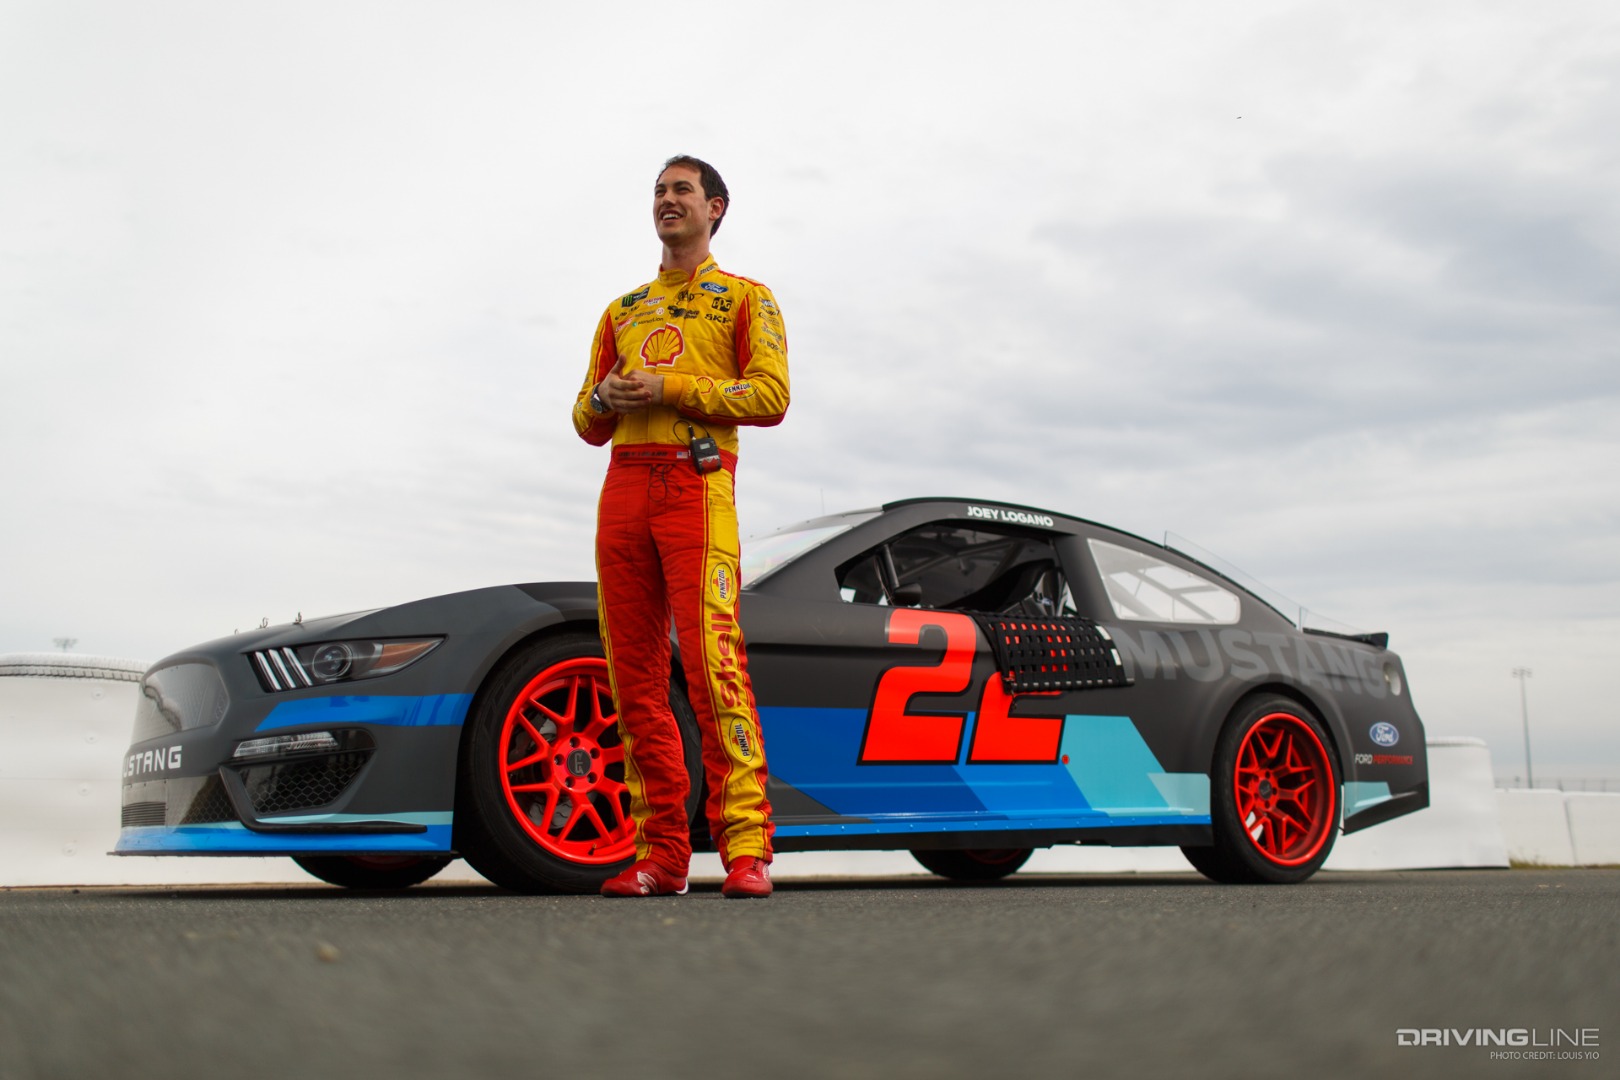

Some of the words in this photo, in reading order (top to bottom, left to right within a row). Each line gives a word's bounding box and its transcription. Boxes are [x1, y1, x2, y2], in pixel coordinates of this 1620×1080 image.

[703, 282, 725, 293] Ford
[712, 297, 732, 311] PPG
[704, 313, 732, 323] SKF
[724, 383, 751, 394] PENNZOIL
[967, 505, 999, 520] JOEY
[1001, 510, 1054, 527] LOGANO
[717, 569, 727, 600] PENNZOIL
[711, 613, 742, 708] Shell
[1111, 627, 1388, 699] MUSTANG
[734, 723, 750, 756] PENNZOIL
[1374, 724, 1395, 743] Ford
[1355, 753, 1373, 764] FORD
